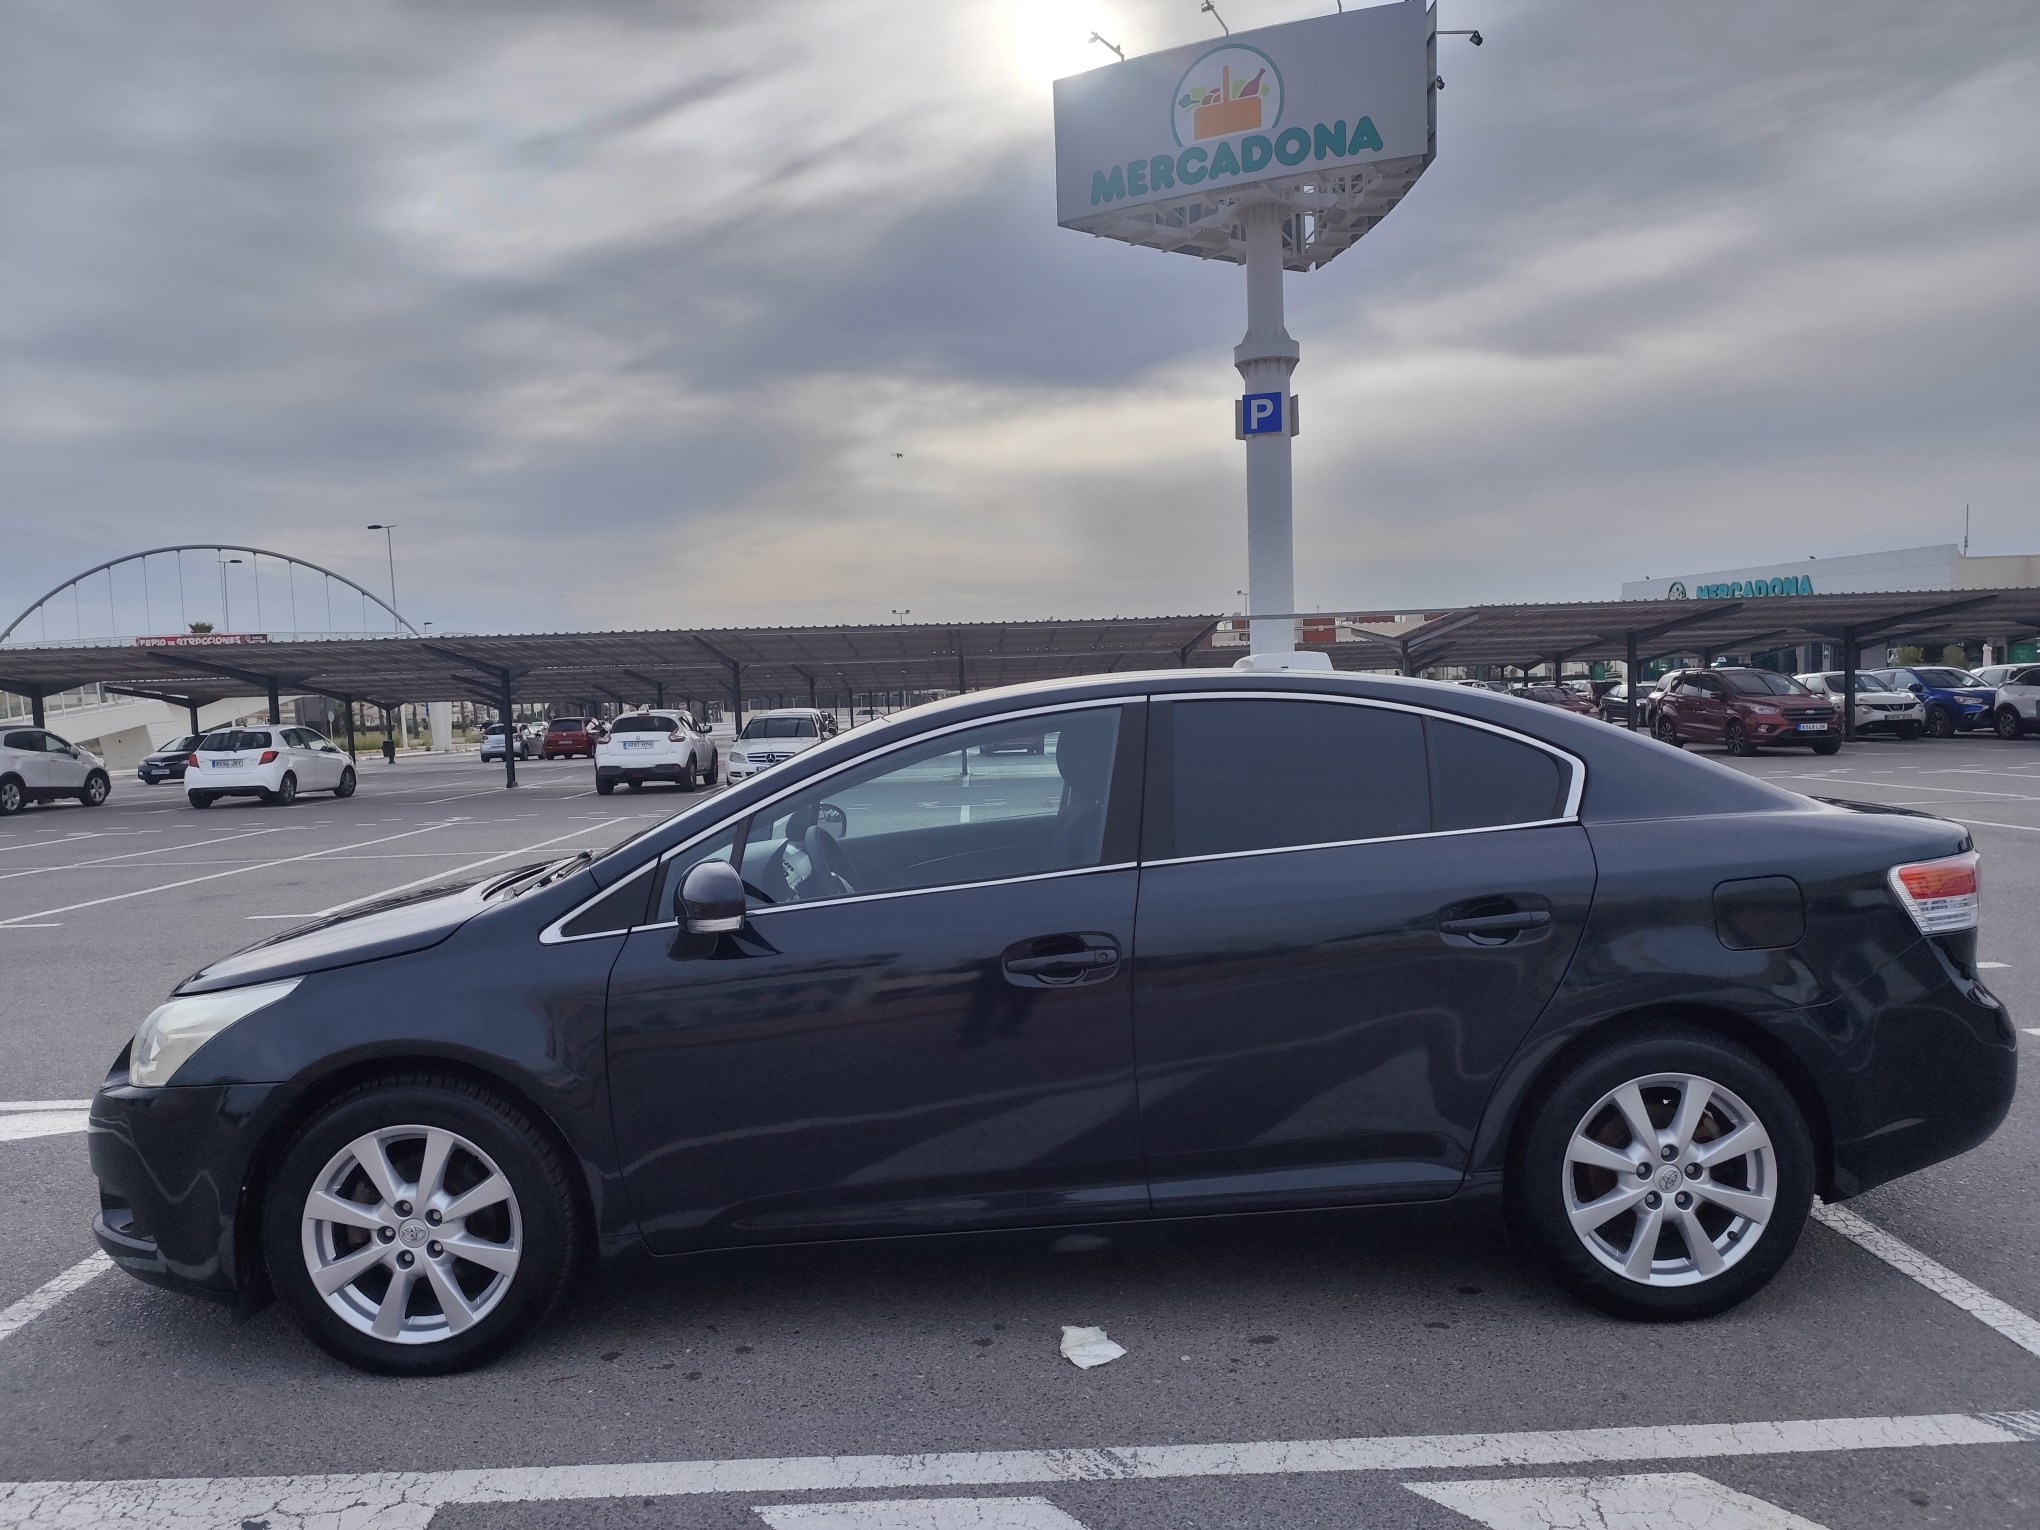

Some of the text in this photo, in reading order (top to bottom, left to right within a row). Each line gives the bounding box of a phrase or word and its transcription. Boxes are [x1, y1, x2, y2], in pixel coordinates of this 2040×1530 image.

[1090, 115, 1384, 206] MERCADONA
[1250, 398, 1274, 430] P
[1696, 574, 1814, 599] MERCADONA
